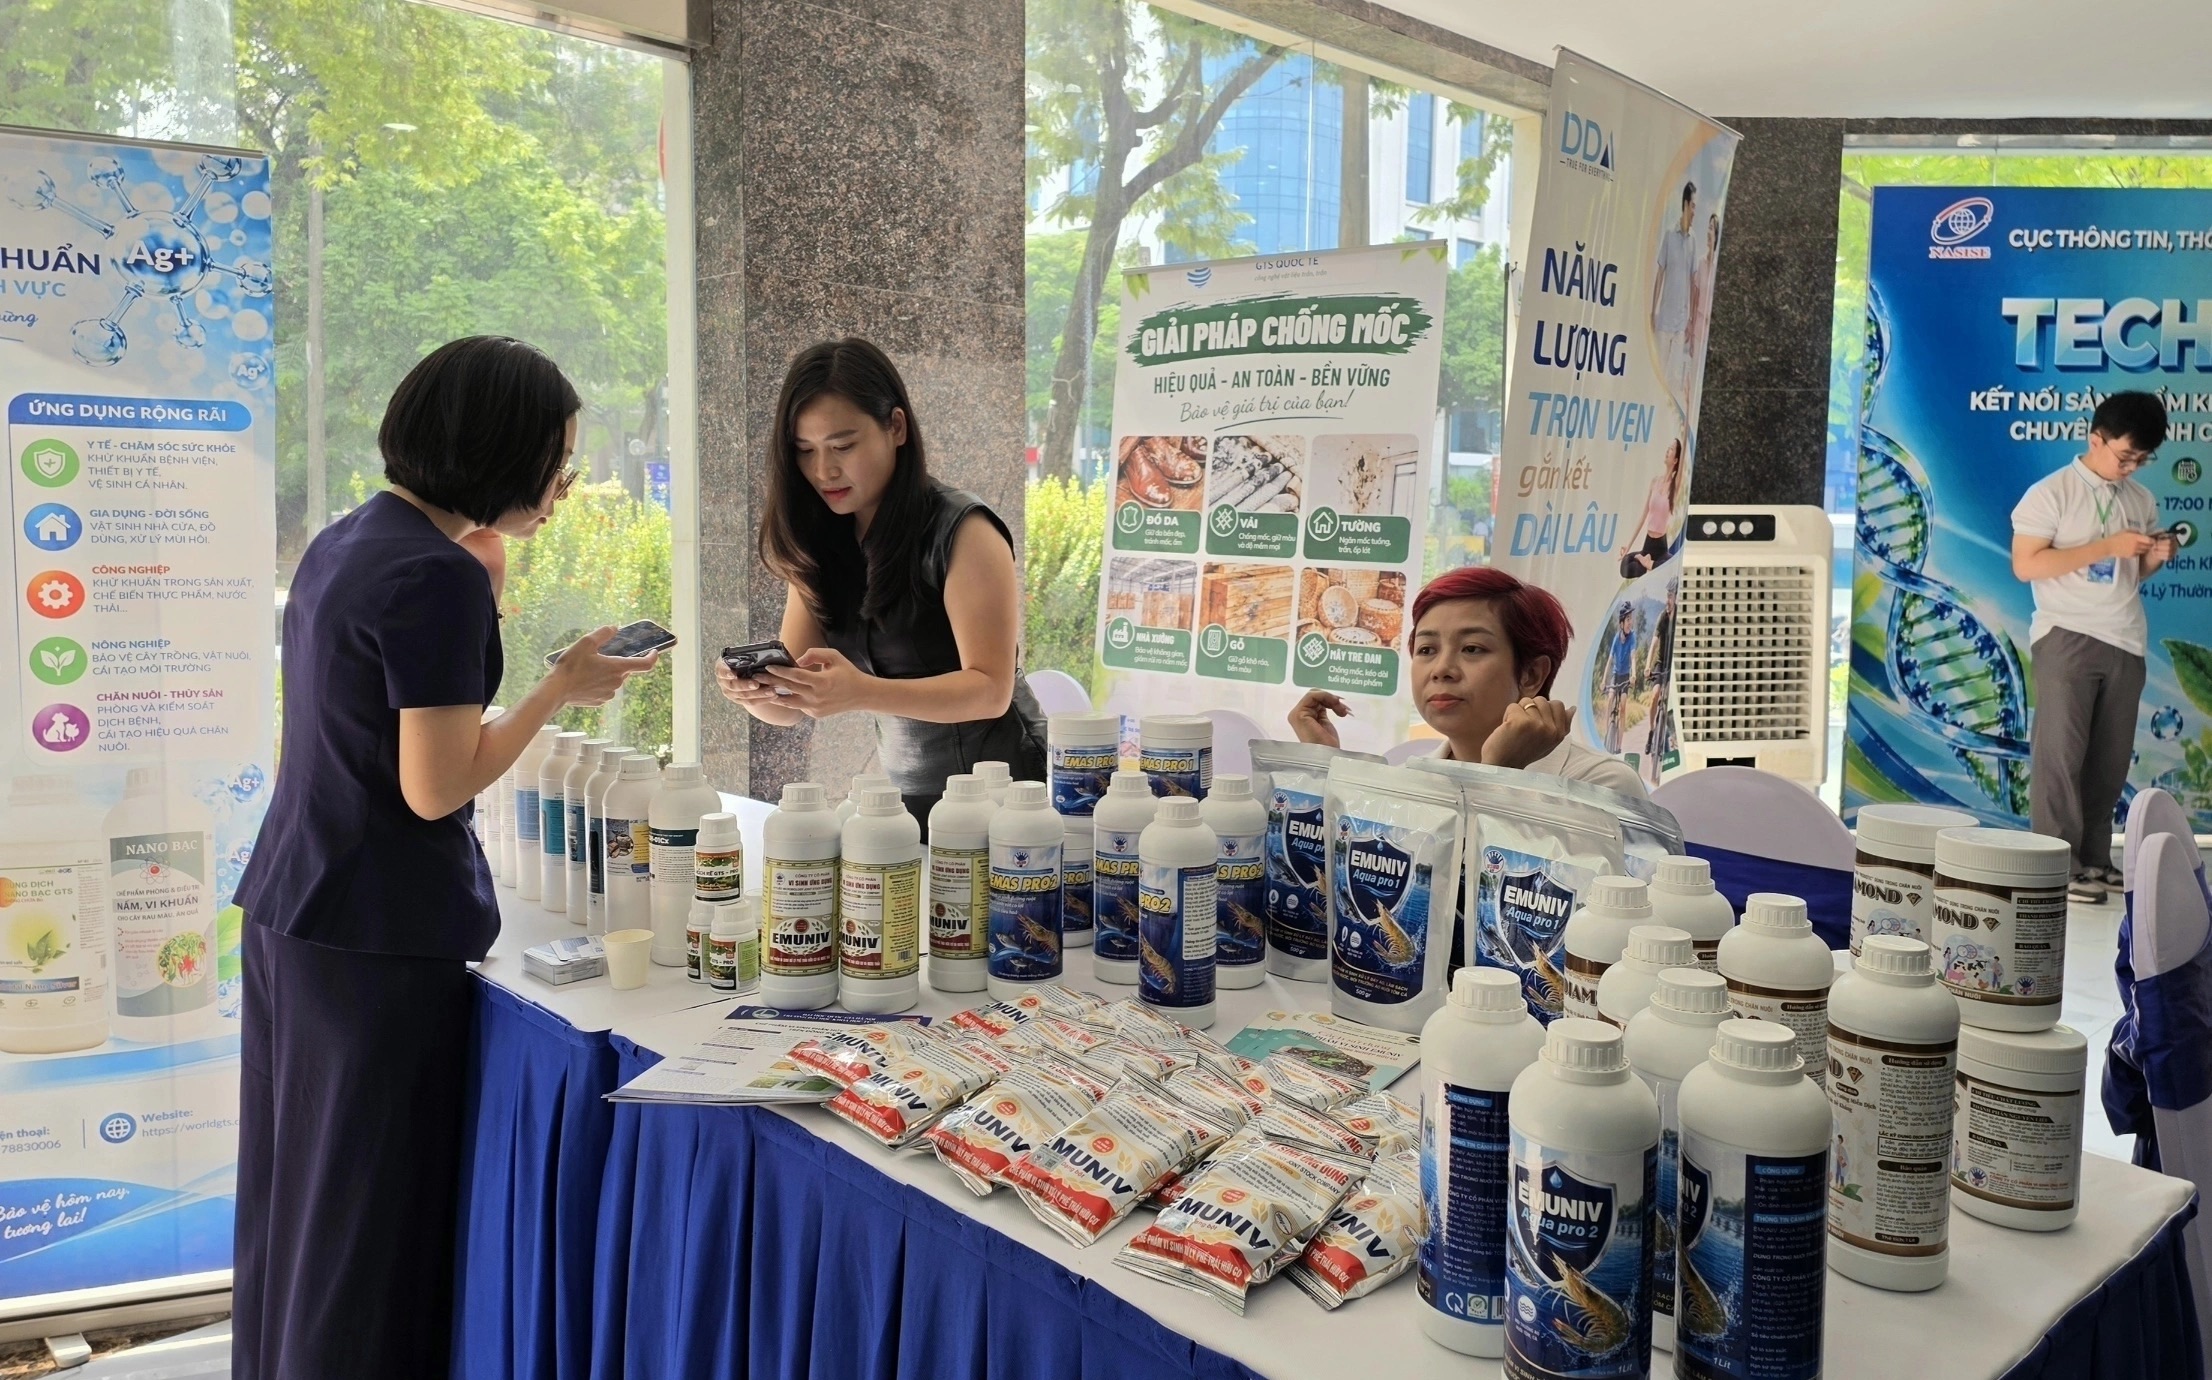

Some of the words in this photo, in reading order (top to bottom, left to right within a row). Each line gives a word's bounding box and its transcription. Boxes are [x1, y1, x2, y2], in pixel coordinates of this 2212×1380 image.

[1566, 157, 1577, 170] TRUE
[1578, 160, 1588, 172] FOR
[2009, 228, 2054, 252] CỤC
[2056, 224, 2131, 249] THÔNG
[2134, 229, 2172, 253] TIN,
[126, 240, 194, 272] Ag+
[1541, 240, 1618, 307] NĂNG
[14, 280, 66, 300] VỰC
[1141, 317, 1188, 356] GIẢI
[1192, 312, 1258, 351] PHÁP
[1261, 304, 1347, 346] CHỐNG
[1351, 302, 1411, 345] MỐC
[1533, 319, 1628, 381] LƯỢNG
[1154, 371, 1185, 398] HIỆU
[1190, 367, 1216, 391] QUẢ
[1231, 370, 1252, 388] AN
[1257, 364, 1294, 386] TOÀN
[1311, 360, 1341, 386] BỀN
[1347, 364, 1391, 388] VỮNG
[1180, 402, 1208, 422] Bảo
[1212, 400, 1230, 417] vệ
[1232, 397, 1254, 420] giá
[1258, 394, 1280, 414] trị
[1283, 396, 1311, 411] của
[1314, 388, 1354, 414] bạn!
[1970, 384, 2014, 412] KẾT
[2018, 385, 2061, 412] NỐI
[29, 400, 74, 417] ỨNG
[80, 402, 136, 421] DỤNG
[140, 404, 193, 423] RỘNG
[198, 407, 226, 422] RÃI
[1528, 391, 1601, 448] TRỌN
[1607, 400, 1655, 452] VẸN
[87, 441, 95, 450] Y
[97, 438, 112, 450] TẾ
[120, 442, 154, 451] CHĂM
[157, 442, 180, 452] SÓC
[182, 441, 204, 452] SỨC
[206, 443, 236, 453] KHỎE
[88, 454, 113, 464] KHỬ
[159, 455, 189, 466] BỆNH
[192, 455, 218, 467] VIỆN,
[88, 464, 120, 476] THIẾT
[123, 467, 134, 478] BỊ
[136, 468, 144, 476] Y
[1518, 452, 1561, 498] gắn
[1564, 456, 1592, 490] kết
[88, 479, 103, 490] VỆ
[106, 480, 132, 489] SINH
[135, 479, 151, 490] CÁ
[153, 480, 188, 490] NHÂN.
[2164, 496, 2204, 511] 17:00
[90, 510, 110, 518] GIA
[112, 510, 146, 520] DỤNG
[154, 508, 176, 519] ĐỜI
[178, 508, 210, 519] SỐNG
[1164, 516, 1179, 526] DA
[116, 522, 142, 531] SINH
[144, 521, 169, 531] NHÀ
[199, 520, 216, 532] ĐỒ
[1240, 516, 1258, 529] VẢI
[1341, 519, 1382, 533] TƯỜNG
[1510, 501, 1562, 557] DÀI
[1563, 500, 1618, 553] LÂU
[91, 533, 127, 546] DÙNG,
[150, 532, 162, 544] LÝ
[164, 534, 186, 544] MÙI
[92, 565, 126, 574] CÔNG
[128, 564, 171, 576] NGHIỆP
[164, 578, 202, 587] TRONG
[93, 588, 116, 600] CHẾ
[118, 589, 146, 600] BIẾN
[148, 590, 178, 600] THỰC
[216, 590, 248, 600] NƯỚC
[1136, 630, 1150, 642] NHÀ
[92, 640, 127, 650] NÔNG
[129, 638, 171, 650] NGHIỆP
[118, 652, 133, 663] VỆ
[136, 652, 157, 661] CÂY
[203, 650, 222, 662] VẬT
[1330, 648, 1346, 662] MÂY
[1348, 652, 1363, 662] TRE
[114, 666, 137, 678] TẠO
[140, 663, 162, 674] MÔI
[164, 662, 212, 674] TRƯỜNG
[96, 692, 130, 702] CHĂN
[132, 690, 161, 700] NUÔI
[170, 689, 200, 700] THỦY
[98, 704, 138, 714] PHÒNG
[140, 702, 156, 713] VÀ
[188, 702, 214, 711] SOÁT
[98, 718, 126, 729] DỊCH
[128, 716, 162, 727] BỆNH,
[120, 730, 142, 741] TẠO
[145, 728, 170, 740] HIỆU
[1063, 755, 1092, 769] EMAS
[126, 840, 168, 856] NANO
[172, 840, 198, 852] BẠC
[1292, 836, 1314, 851] Aqua
[1230, 862, 1264, 880] PRO2
[1350, 850, 1408, 877] EMUNIV
[1021, 874, 1059, 892] PRO2
[1352, 868, 1377, 883] Aqua
[1376, 876, 1394, 887] pro
[1395, 880, 1400, 888] 1
[1504, 884, 1568, 918] EMUNIV
[1506, 906, 1533, 922] Aqua
[1532, 915, 1552, 928] pro
[1553, 919, 1559, 930] 1
[772, 930, 830, 945] EMUNIV
[142, 1109, 194, 1124] Website:
[16, 1127, 50, 1138] thoại:
[1318, 1162, 1350, 1188] DỤNG
[1316, 1176, 1340, 1195] COMPANY
[32, 1199, 52, 1217] vệ
[56, 1194, 92, 1209] hôm
[1518, 1181, 1604, 1222] EMUNIV
[4, 1222, 54, 1240] tương
[57, 1206, 88, 1226] lai!
[1521, 1206, 1555, 1234] Aqua
[1556, 1222, 1585, 1239] pro
[1588, 1226, 1599, 1239] 2
